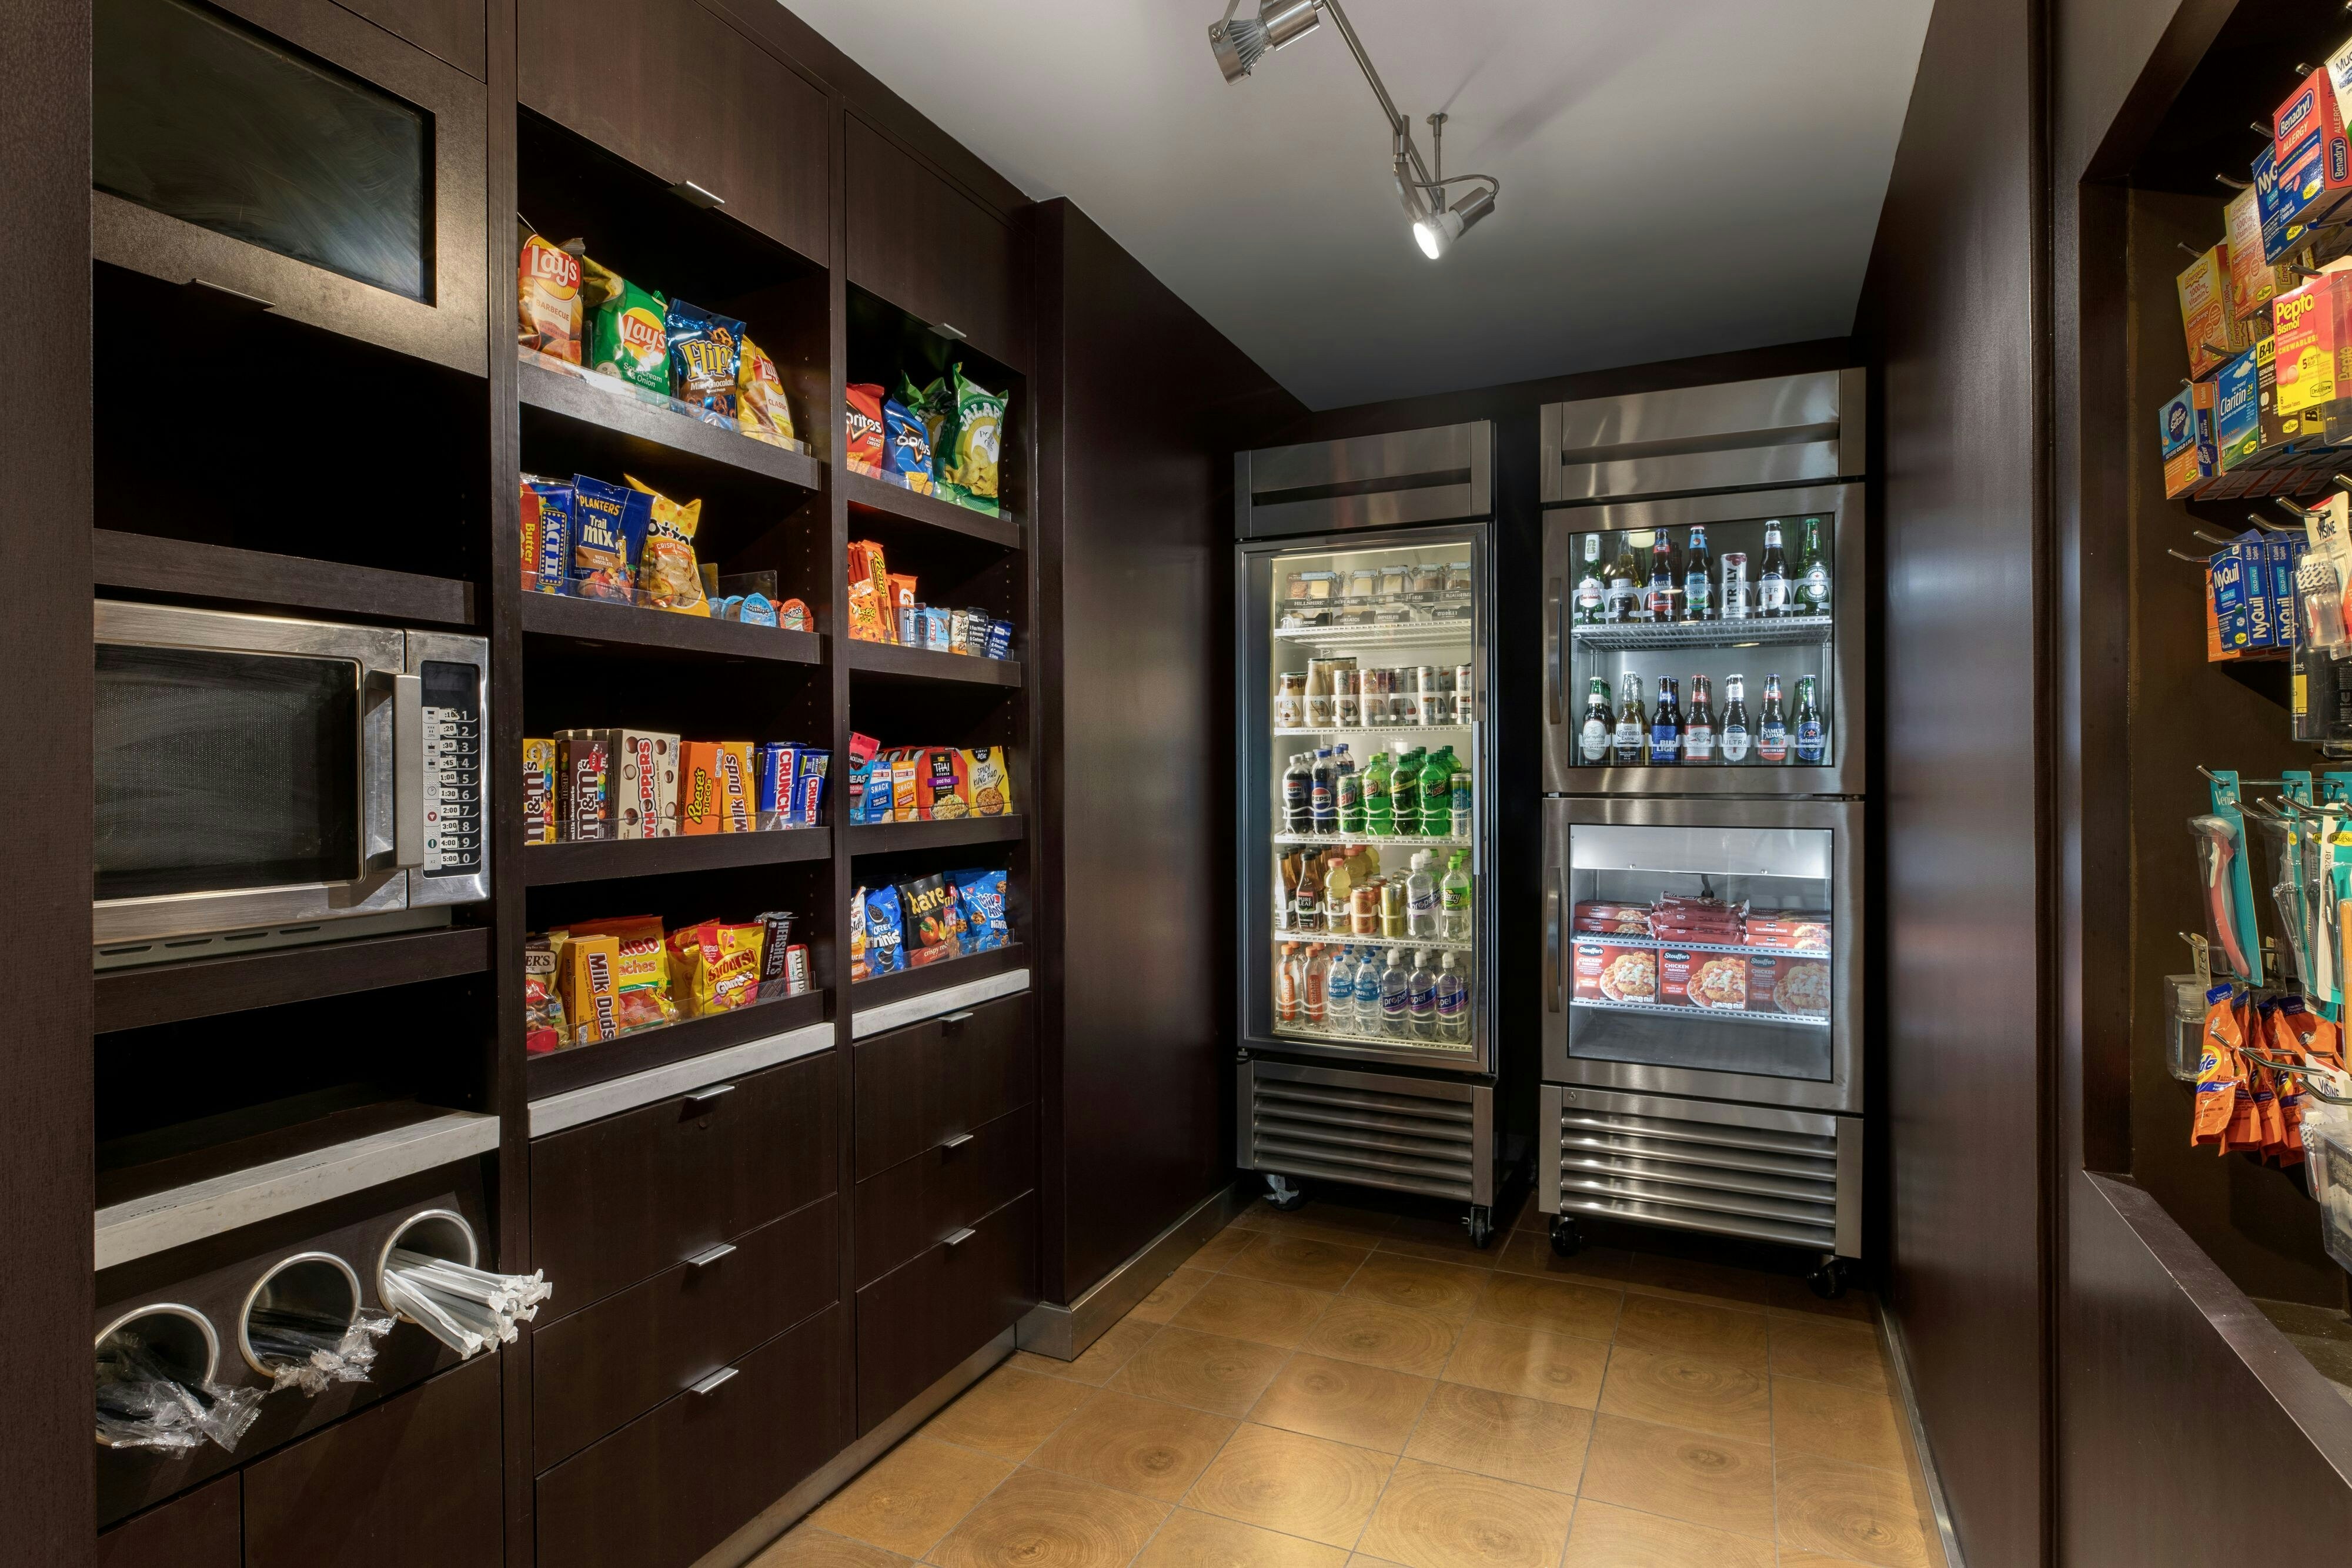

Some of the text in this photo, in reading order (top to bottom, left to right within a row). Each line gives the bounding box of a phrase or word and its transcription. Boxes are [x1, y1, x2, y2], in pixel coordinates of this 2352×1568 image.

[2280, 95, 2310, 135] Benadryl
[2333, 102, 2341, 133] ALLERGY
[2283, 122, 2308, 154] ALLERGY
[2333, 142, 2343, 178] Benadryl
[531, 245, 577, 287] Lay's
[2189, 284, 2201, 296] 1000
[2189, 291, 2204, 306] Vitamin
[536, 299, 570, 322] BARBECUE
[2276, 292, 2315, 324] Pepto
[2188, 310, 2209, 329] Super Orange
[2277, 314, 2301, 336] Bismol
[623, 316, 666, 353] Lay's
[2278, 334, 2318, 355] CHEWABLES
[2259, 365, 2274, 377] GENUINE
[2303, 358, 2308, 369] 5
[636, 375, 656, 388] Onion
[640, 369, 663, 384] Cream
[2220, 387, 2246, 416] Claritin
[2170, 410, 2186, 432] Seltzer
[2171, 407, 2183, 423] Alka-
[2165, 443, 2186, 459] SEVERE COLD
[578, 494, 621, 516] PLANTERS
[590, 514, 607, 530] Trail
[2317, 520, 2336, 540] VISINE
[524, 523, 536, 564] Butter
[583, 524, 614, 547] mix
[544, 517, 560, 576] ACT II
[656, 541, 676, 550] CRISPY
[592, 558, 613, 567] CHOCOLATE
[873, 550, 888, 600] Reese's
[2213, 562, 2240, 592] NyQuil
[1726, 567, 1738, 606] TRULY
[747, 603, 770, 617] TOSTITOS
[783, 606, 802, 621] TOSTITOS
[2249, 597, 2270, 638] NyQuil
[462, 710, 468, 720] 1
[462, 726, 469, 736] 2
[1582, 733, 1606, 741] Yuengling
[462, 742, 469, 752] 3
[462, 758, 470, 768] 4
[933, 762, 950, 773] THAI
[977, 763, 991, 776] SPICY
[462, 774, 469, 784] 5
[776, 750, 792, 817] CRUNCH
[973, 774, 986, 787] KUNG
[988, 770, 997, 780] PAO
[462, 790, 469, 800] 6
[638, 740, 656, 838] WHOPPERS
[687, 766, 706, 825] Reese's
[724, 754, 749, 833] Milk Duds
[871, 783, 889, 793] SNACK
[897, 782, 914, 793] SNACK
[523, 761, 545, 845] m&m's
[577, 759, 599, 840] m&m's
[806, 778, 818, 824] CRUNCH
[2215, 791, 2236, 805] Venus
[462, 805, 470, 816] 7
[462, 821, 470, 832] 8
[462, 837, 470, 848] 9
[463, 853, 470, 864] 0
[907, 887, 946, 915] bare
[1411, 895, 1434, 910] propel
[865, 928, 901, 948] minis
[873, 924, 892, 935] OREO
[770, 921, 790, 975] HERSHEY'S
[924, 946, 939, 957] crispy
[1578, 947, 1603, 955] Stouffer's
[1663, 952, 1690, 960] Stouffer's
[1750, 957, 1776, 966] Stouffer's
[794, 953, 806, 994] ALTOIDS
[589, 952, 617, 1039] Milk Duds
[1384, 988, 1408, 1006] propel
[2318, 1078, 2339, 1098] VISINE
